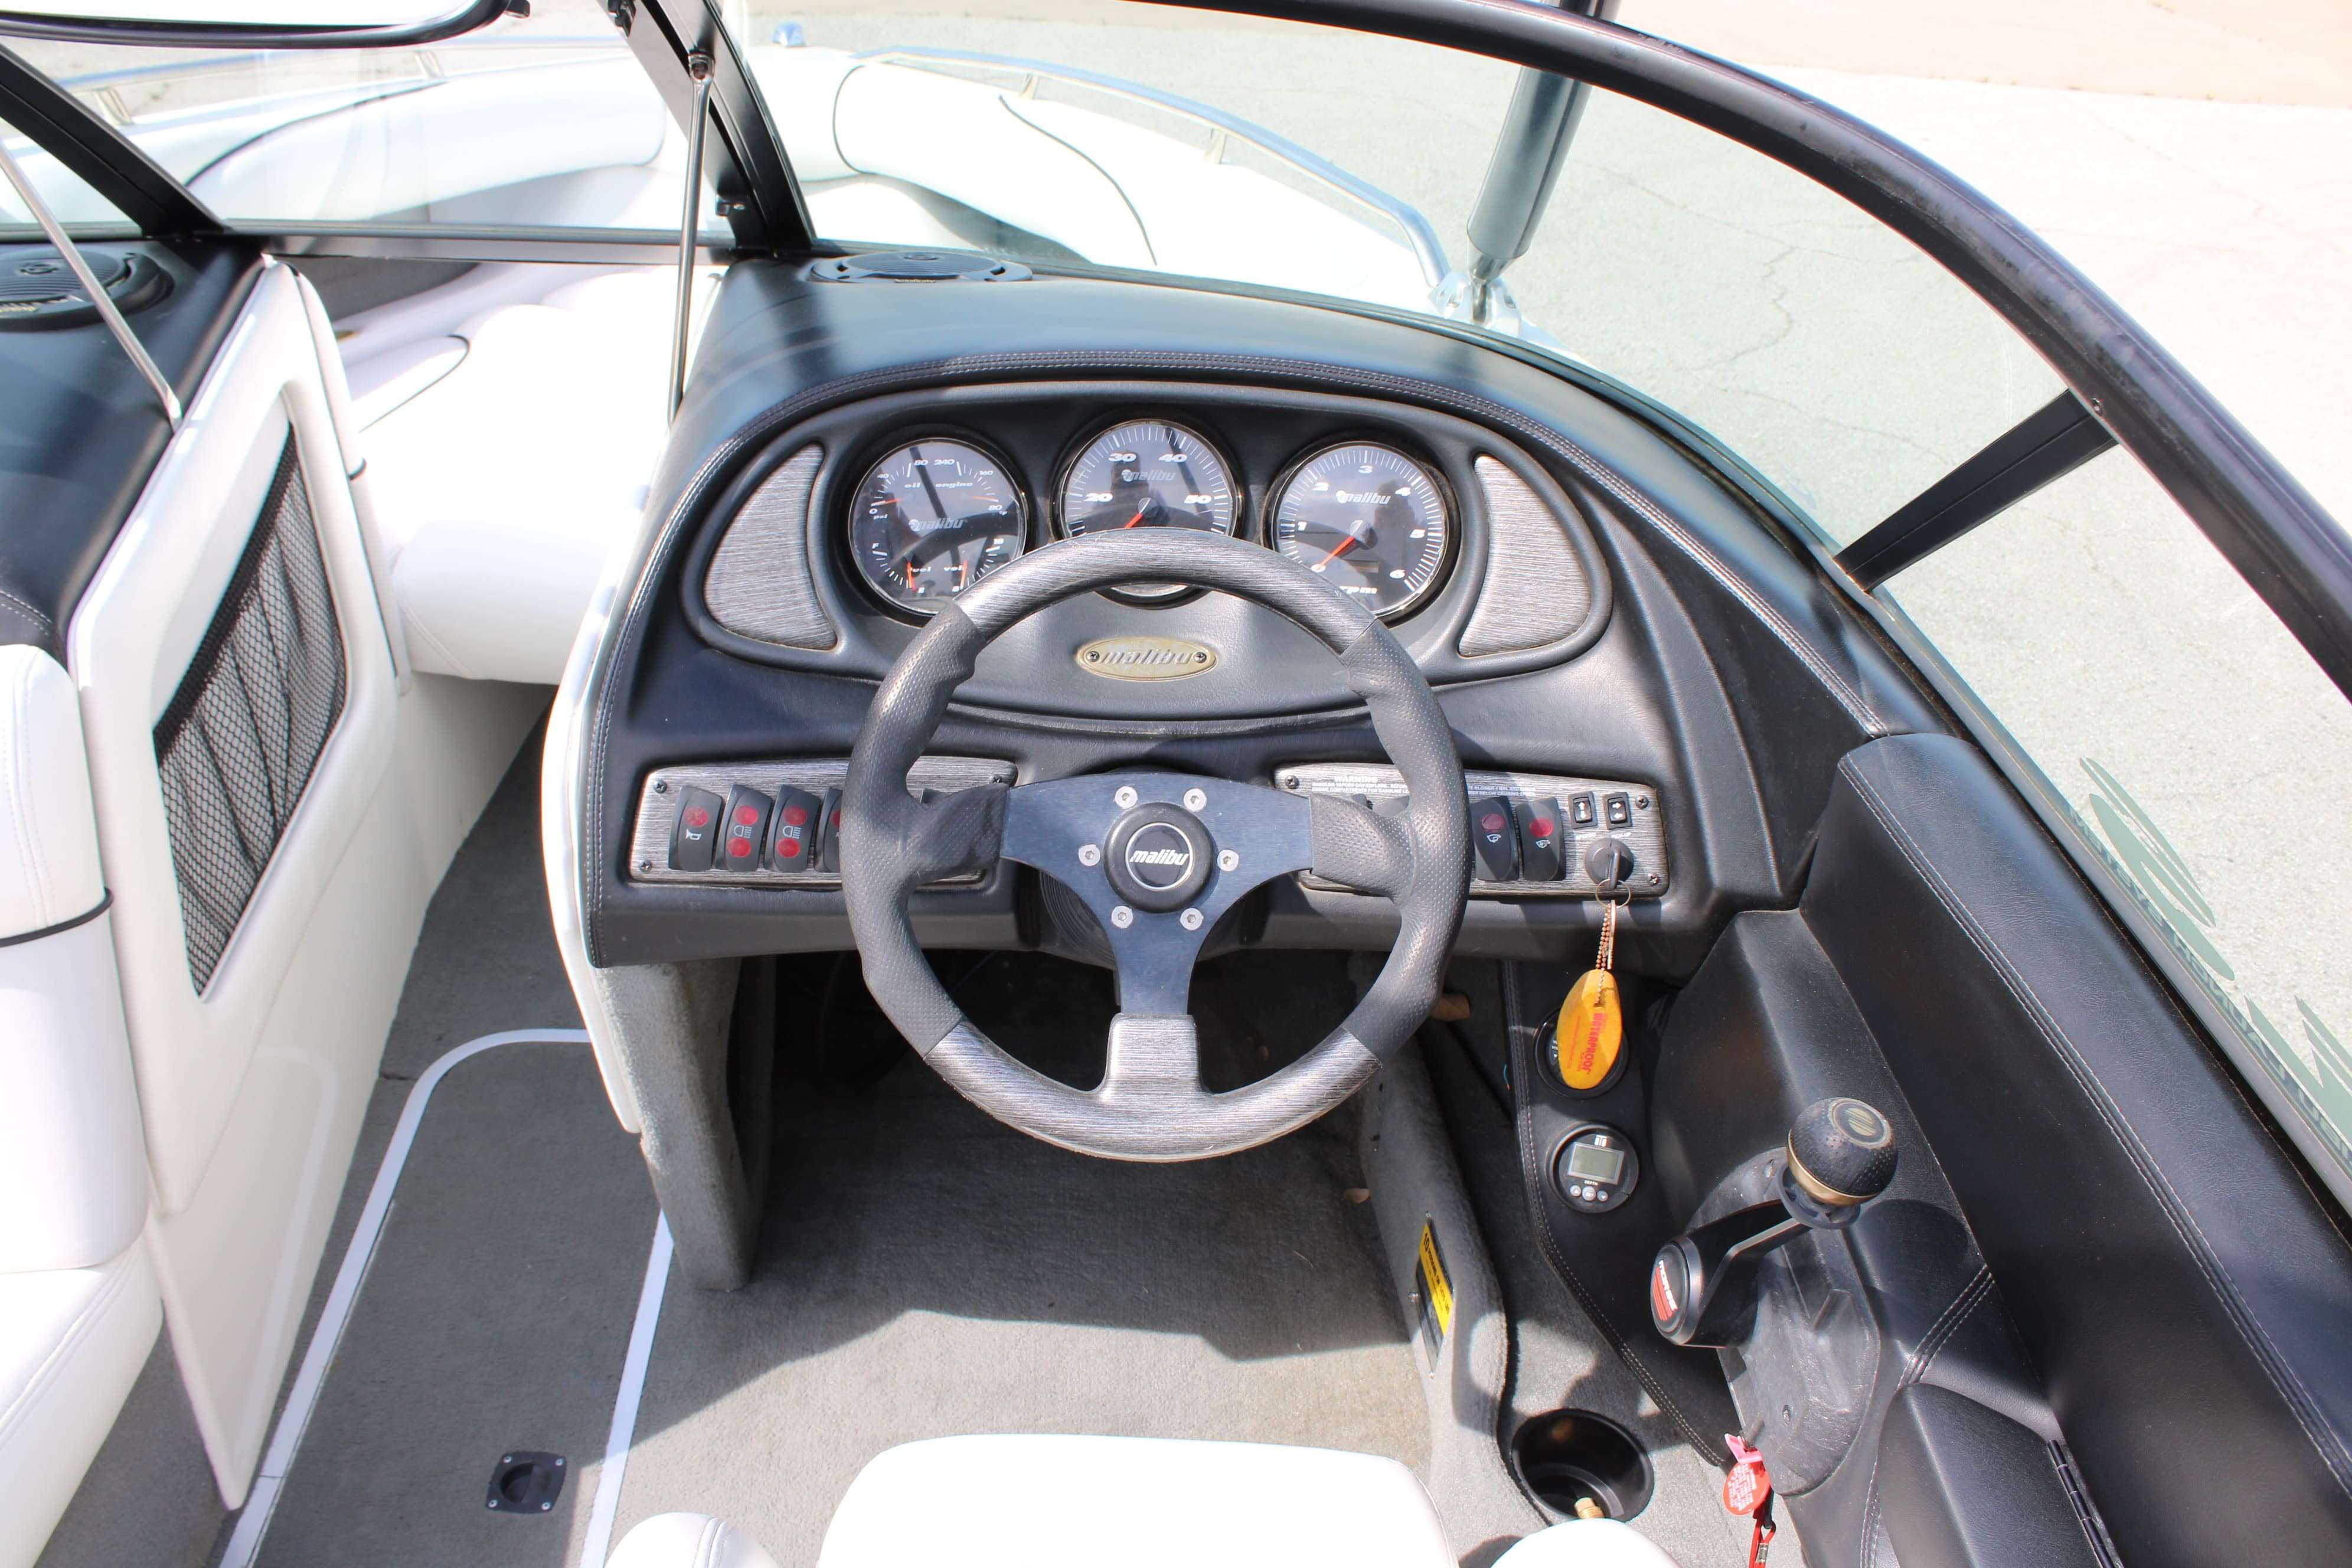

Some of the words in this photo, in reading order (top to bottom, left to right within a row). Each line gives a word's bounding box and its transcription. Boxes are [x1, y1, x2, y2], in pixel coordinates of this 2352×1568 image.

[1109, 453, 1136, 462] 30
[1158, 453, 1188, 463] 40
[1358, 465, 1373, 474] 3
[1312, 482, 1329, 491] 2
[1394, 486, 1411, 496] 4
[1083, 492, 1113, 502] 20
[1184, 495, 1212, 504] 50
[1337, 491, 1391, 505] malibu
[1298, 521, 1307, 531] 1
[1409, 529, 1426, 538] 5
[1389, 569, 1406, 579] 6
[1339, 585, 1378, 594] rpm
[1100, 649, 1193, 665] malibu
[1129, 849, 1189, 865] malibu
